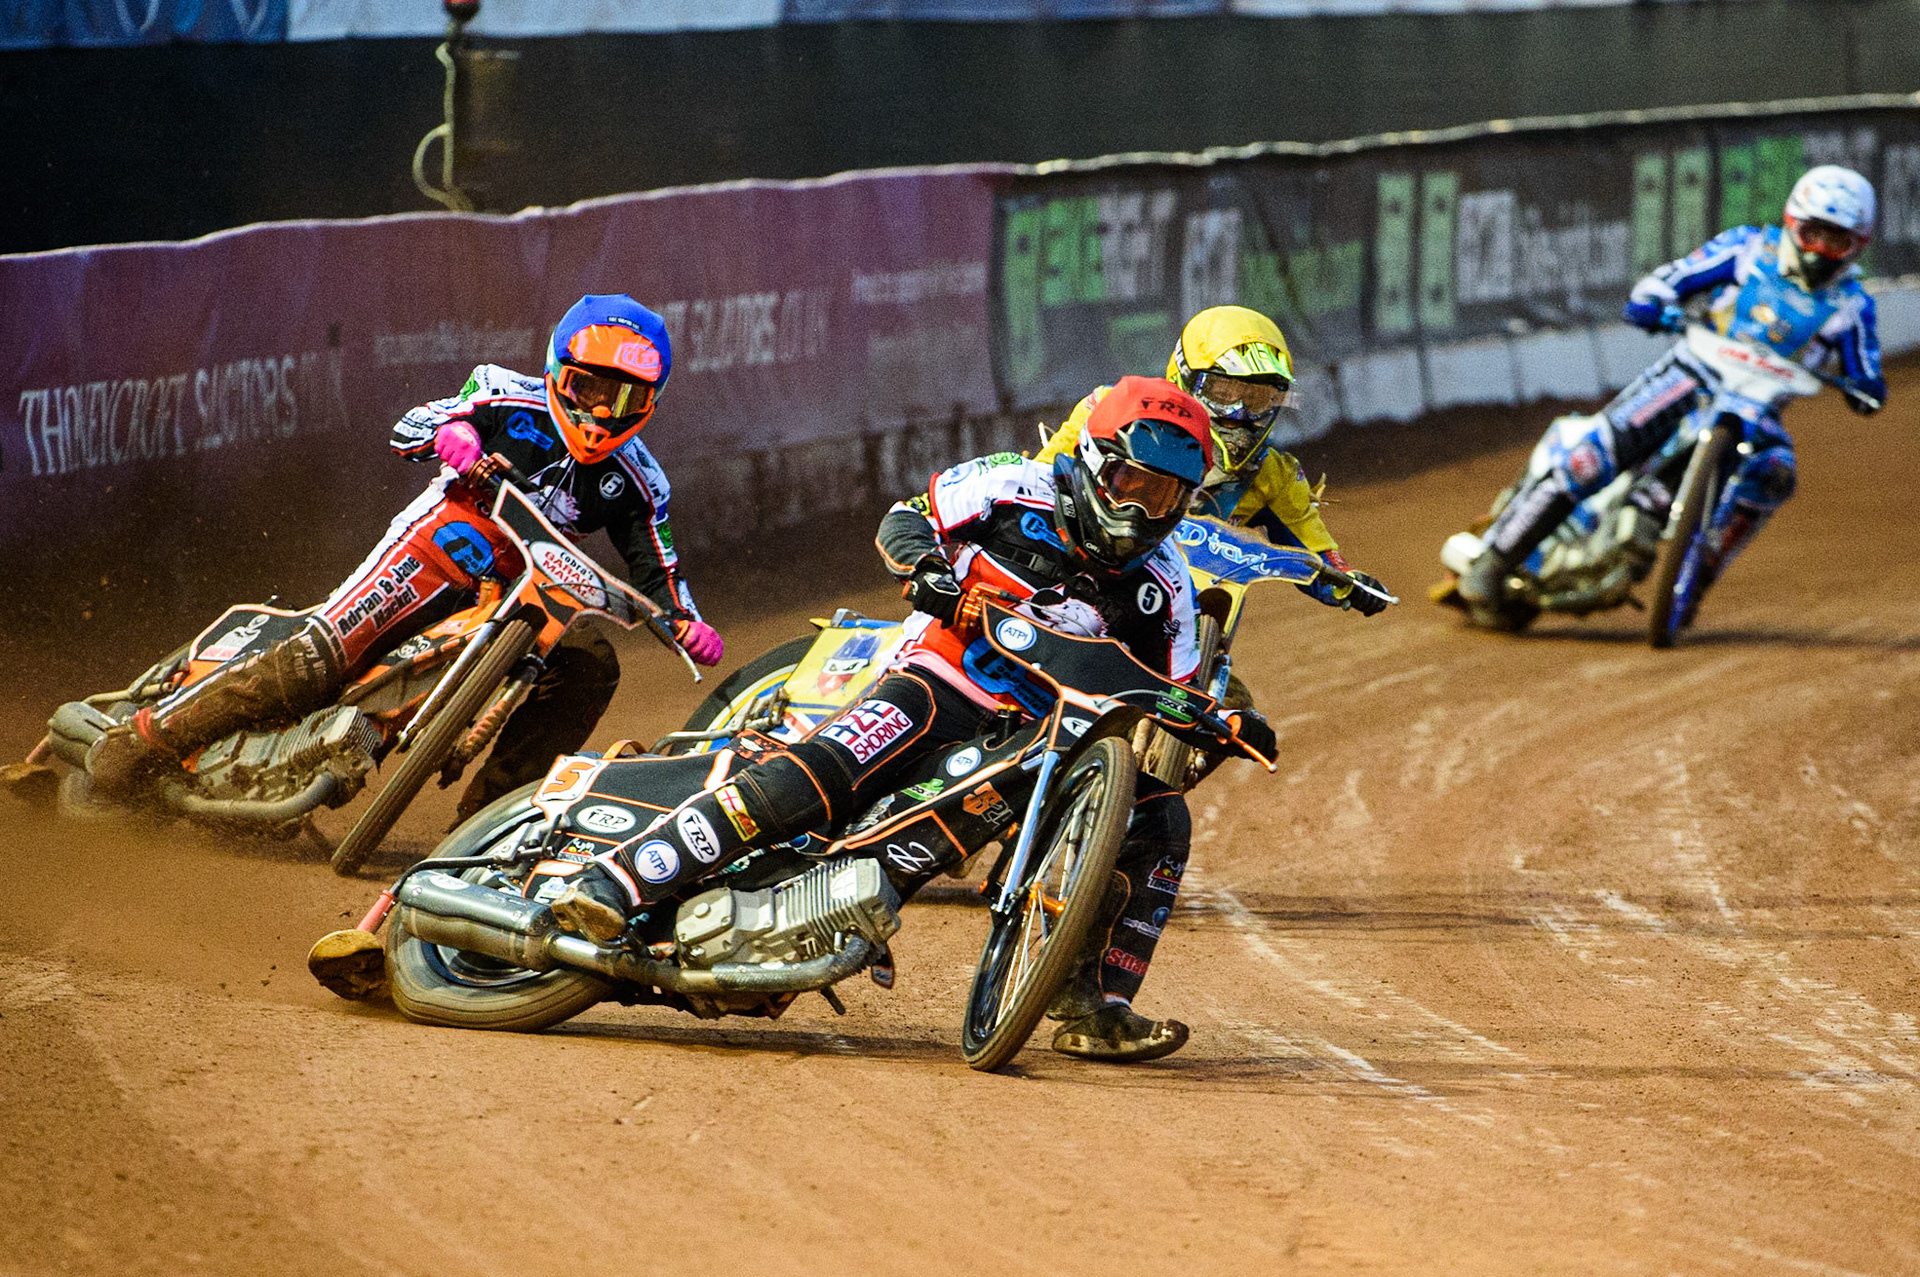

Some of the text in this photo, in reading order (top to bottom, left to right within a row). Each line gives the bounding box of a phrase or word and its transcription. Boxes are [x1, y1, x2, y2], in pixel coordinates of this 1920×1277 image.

[1141, 396, 1193, 419] FRP
[337, 555, 421, 637] Adrian & Jane
[1142, 584, 1159, 612] 5
[1003, 626, 1029, 642] ATPI
[853, 711, 910, 762] SHORING
[542, 761, 596, 796] 5
[646, 849, 669, 876] ATPI
